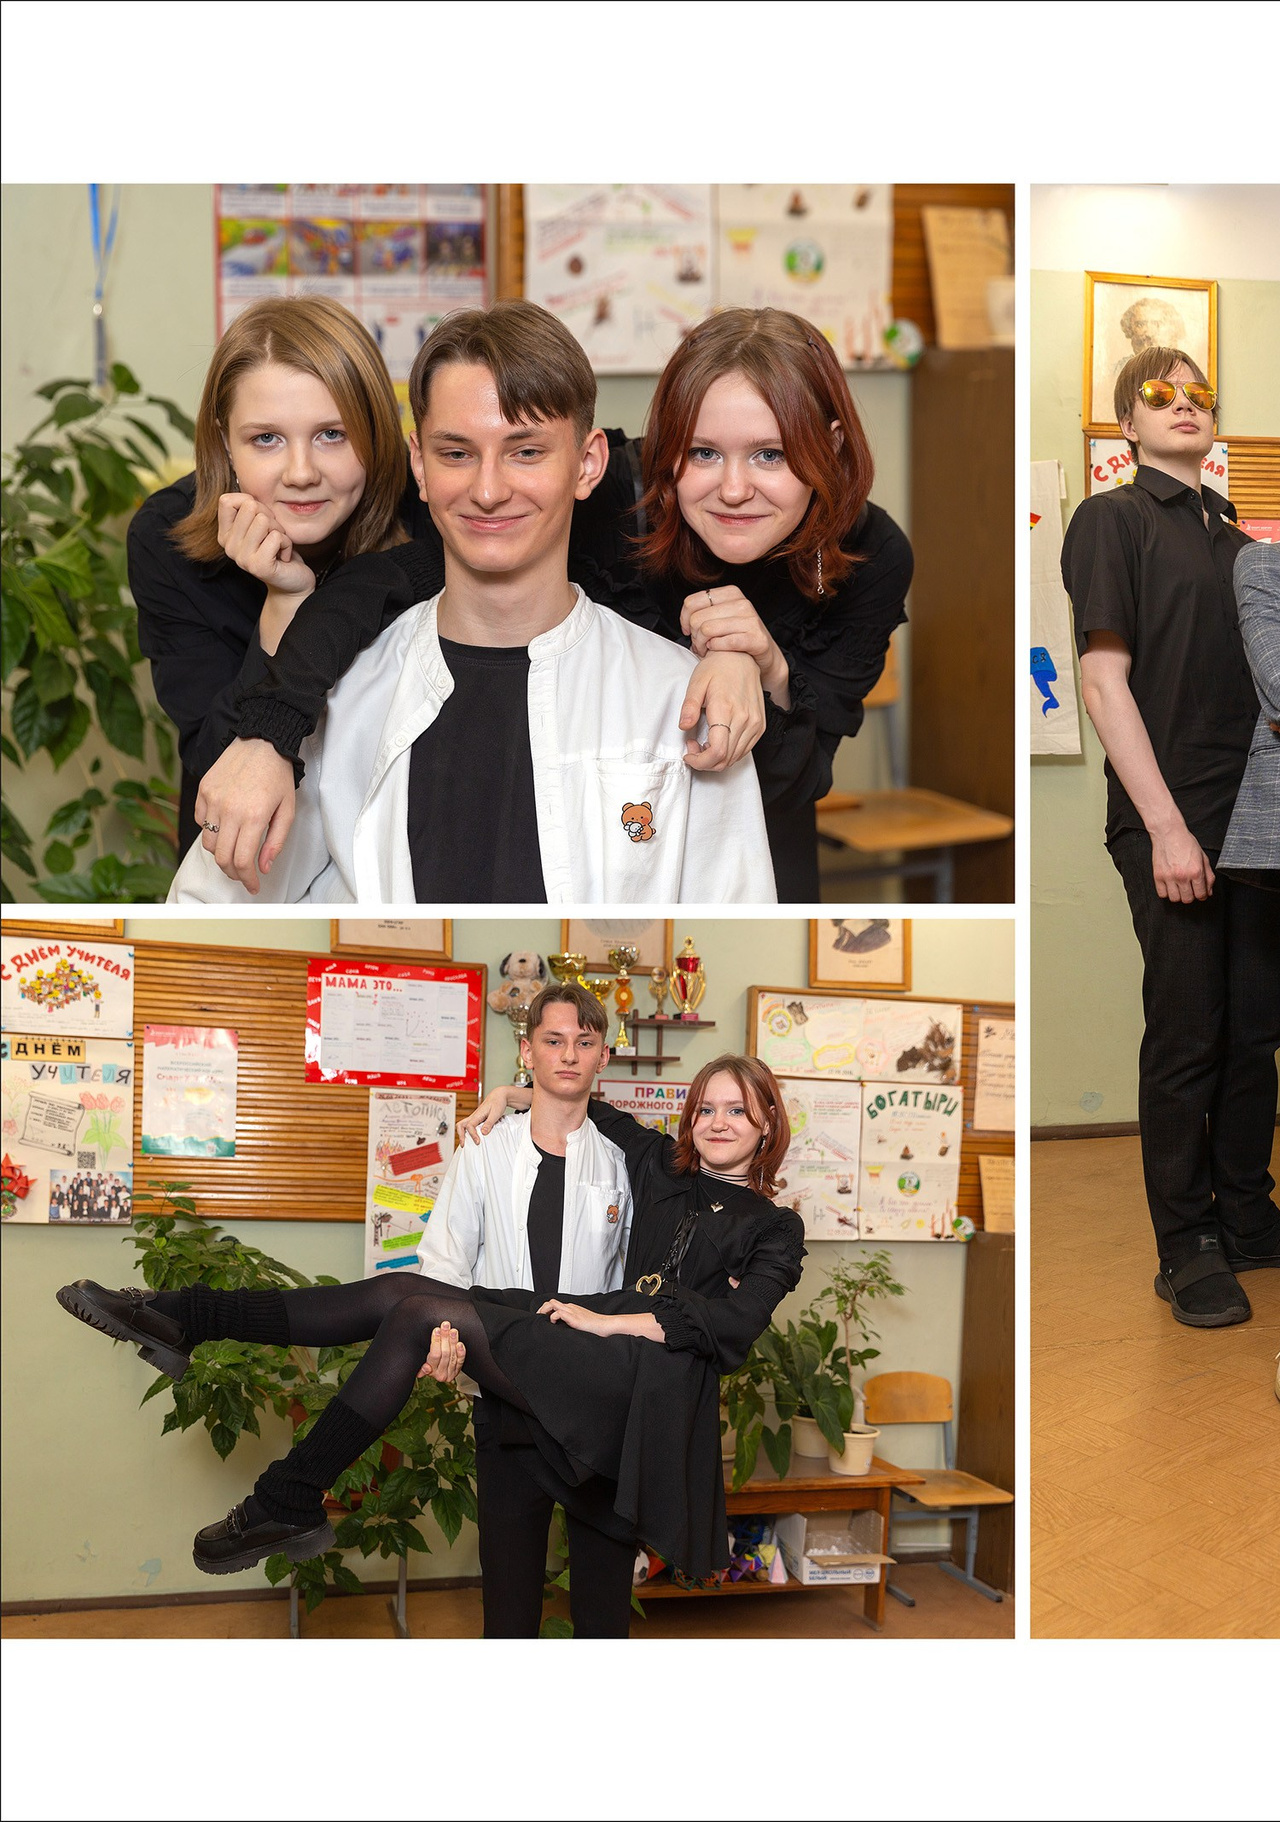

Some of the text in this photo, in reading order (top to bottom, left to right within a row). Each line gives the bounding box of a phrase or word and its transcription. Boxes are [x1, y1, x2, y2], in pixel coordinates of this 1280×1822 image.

[1094, 466, 1109, 482] С
[11, 945, 60, 973] ДНЁМ
[66, 945, 131, 981] УЧИТЕЛЯ
[325, 976, 367, 990] МАМА
[15, 1042, 81, 1056] ДНЁМ
[32, 1064, 131, 1084] УЧИТЕЛЯ
[635, 1087, 686, 1099] ПРАВИ
[866, 1090, 959, 1120] БОГАТЫРИ
